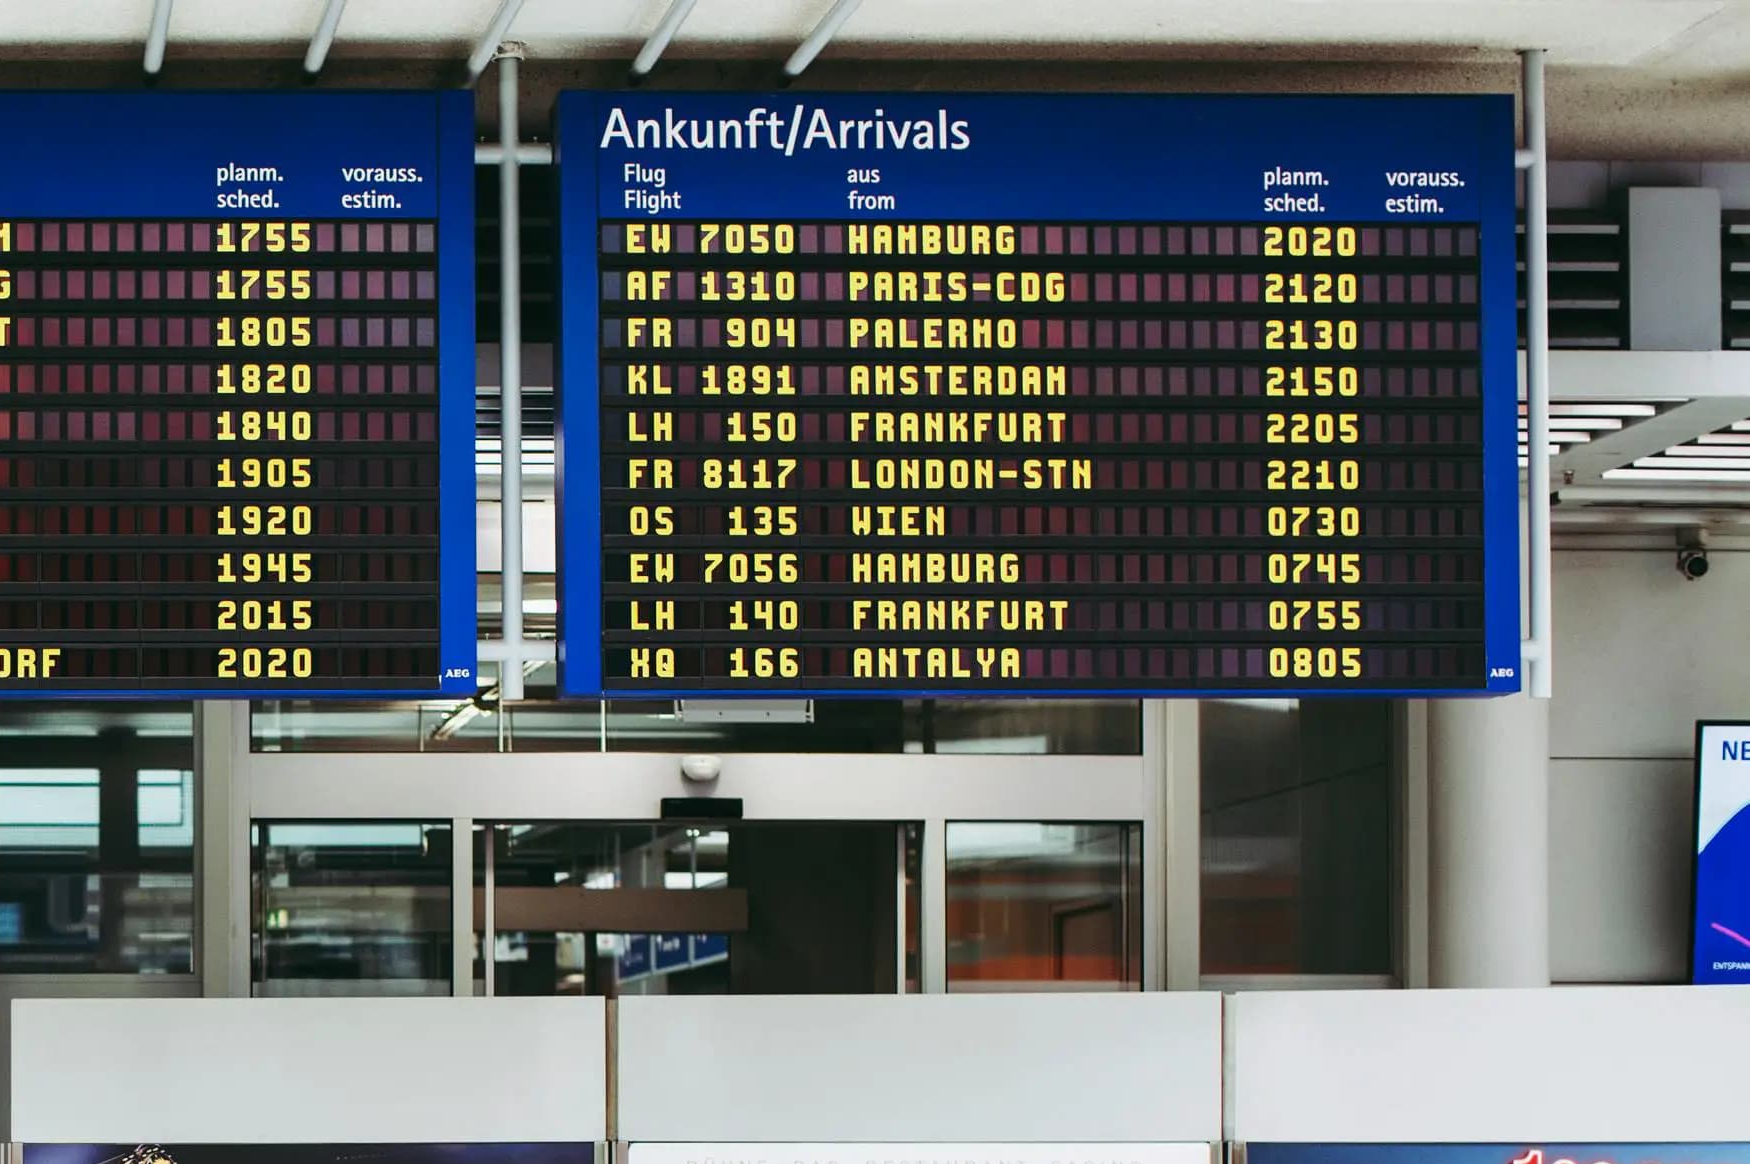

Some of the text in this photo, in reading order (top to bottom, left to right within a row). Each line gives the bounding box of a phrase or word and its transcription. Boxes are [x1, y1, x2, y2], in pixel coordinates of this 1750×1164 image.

[601, 105, 970, 156] Ankunft/Arrivals
[216, 162, 283, 186] planm.
[342, 165, 423, 182] vorauss.
[624, 163, 1464, 190] Flug aus planm. vorauss.
[217, 190, 279, 209] sched.
[341, 190, 401, 209] estim.
[624, 190, 1444, 213] Flight from sched. estim.
[217, 222, 311, 252] 1755
[626, 224, 1356, 257] EW 7050 HAMBURG 2020
[629, 459, 1359, 490] FR 8117 LONDON-STN 2210
[217, 600, 312, 630] 2015
[630, 600, 1360, 631] LH 140 FRANKFURT 0755
[445, 668, 469, 677] AEG
[1490, 668, 1514, 677] AEG
